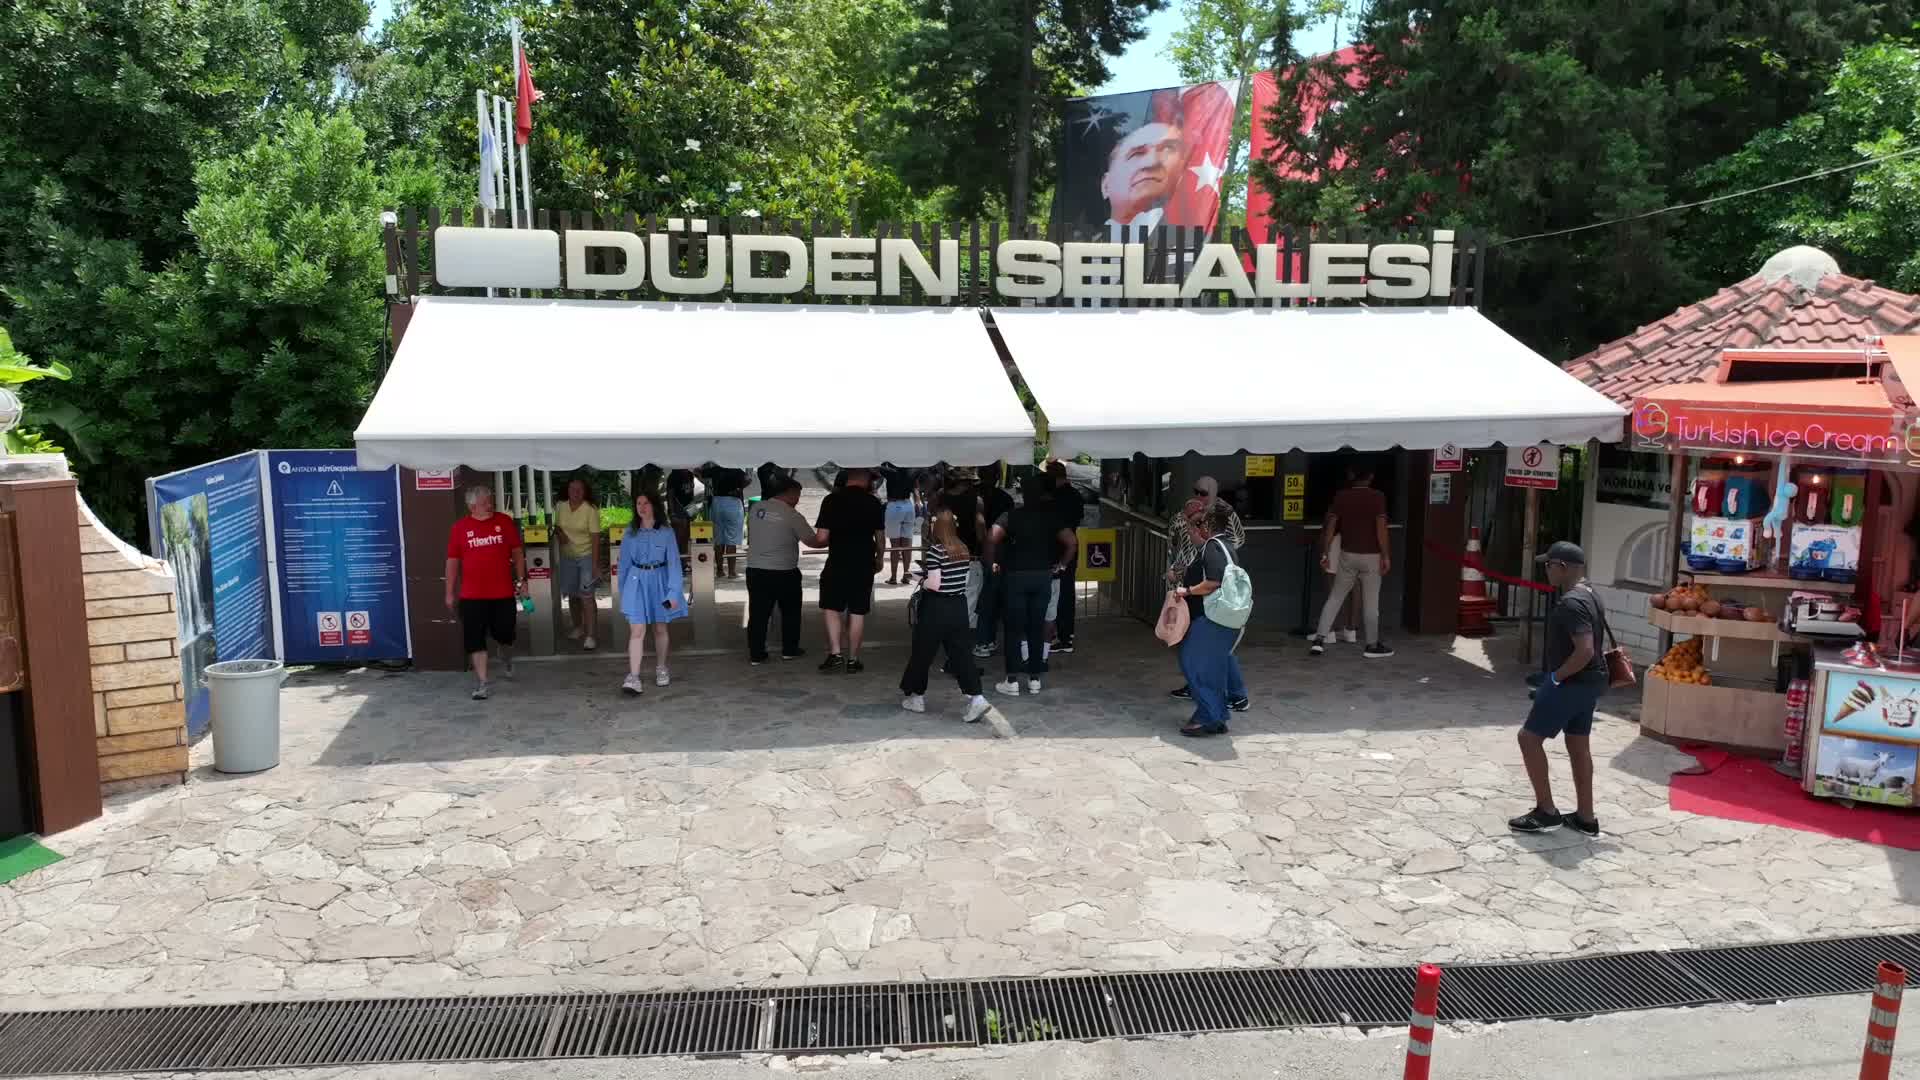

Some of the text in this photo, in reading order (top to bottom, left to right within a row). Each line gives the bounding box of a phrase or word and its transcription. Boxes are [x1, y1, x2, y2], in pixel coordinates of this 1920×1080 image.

[565, 218, 959, 297] DÜDEN
[1675, 416, 1899, 454] Turkish Ice Cream
[291, 465, 317, 473] ANTALYA
[1287, 477, 1298, 488] 50
[1657, 483, 1672, 494] ve
[1287, 502, 1299, 512] 30
[467, 535, 504, 549] TÜRKİYE
